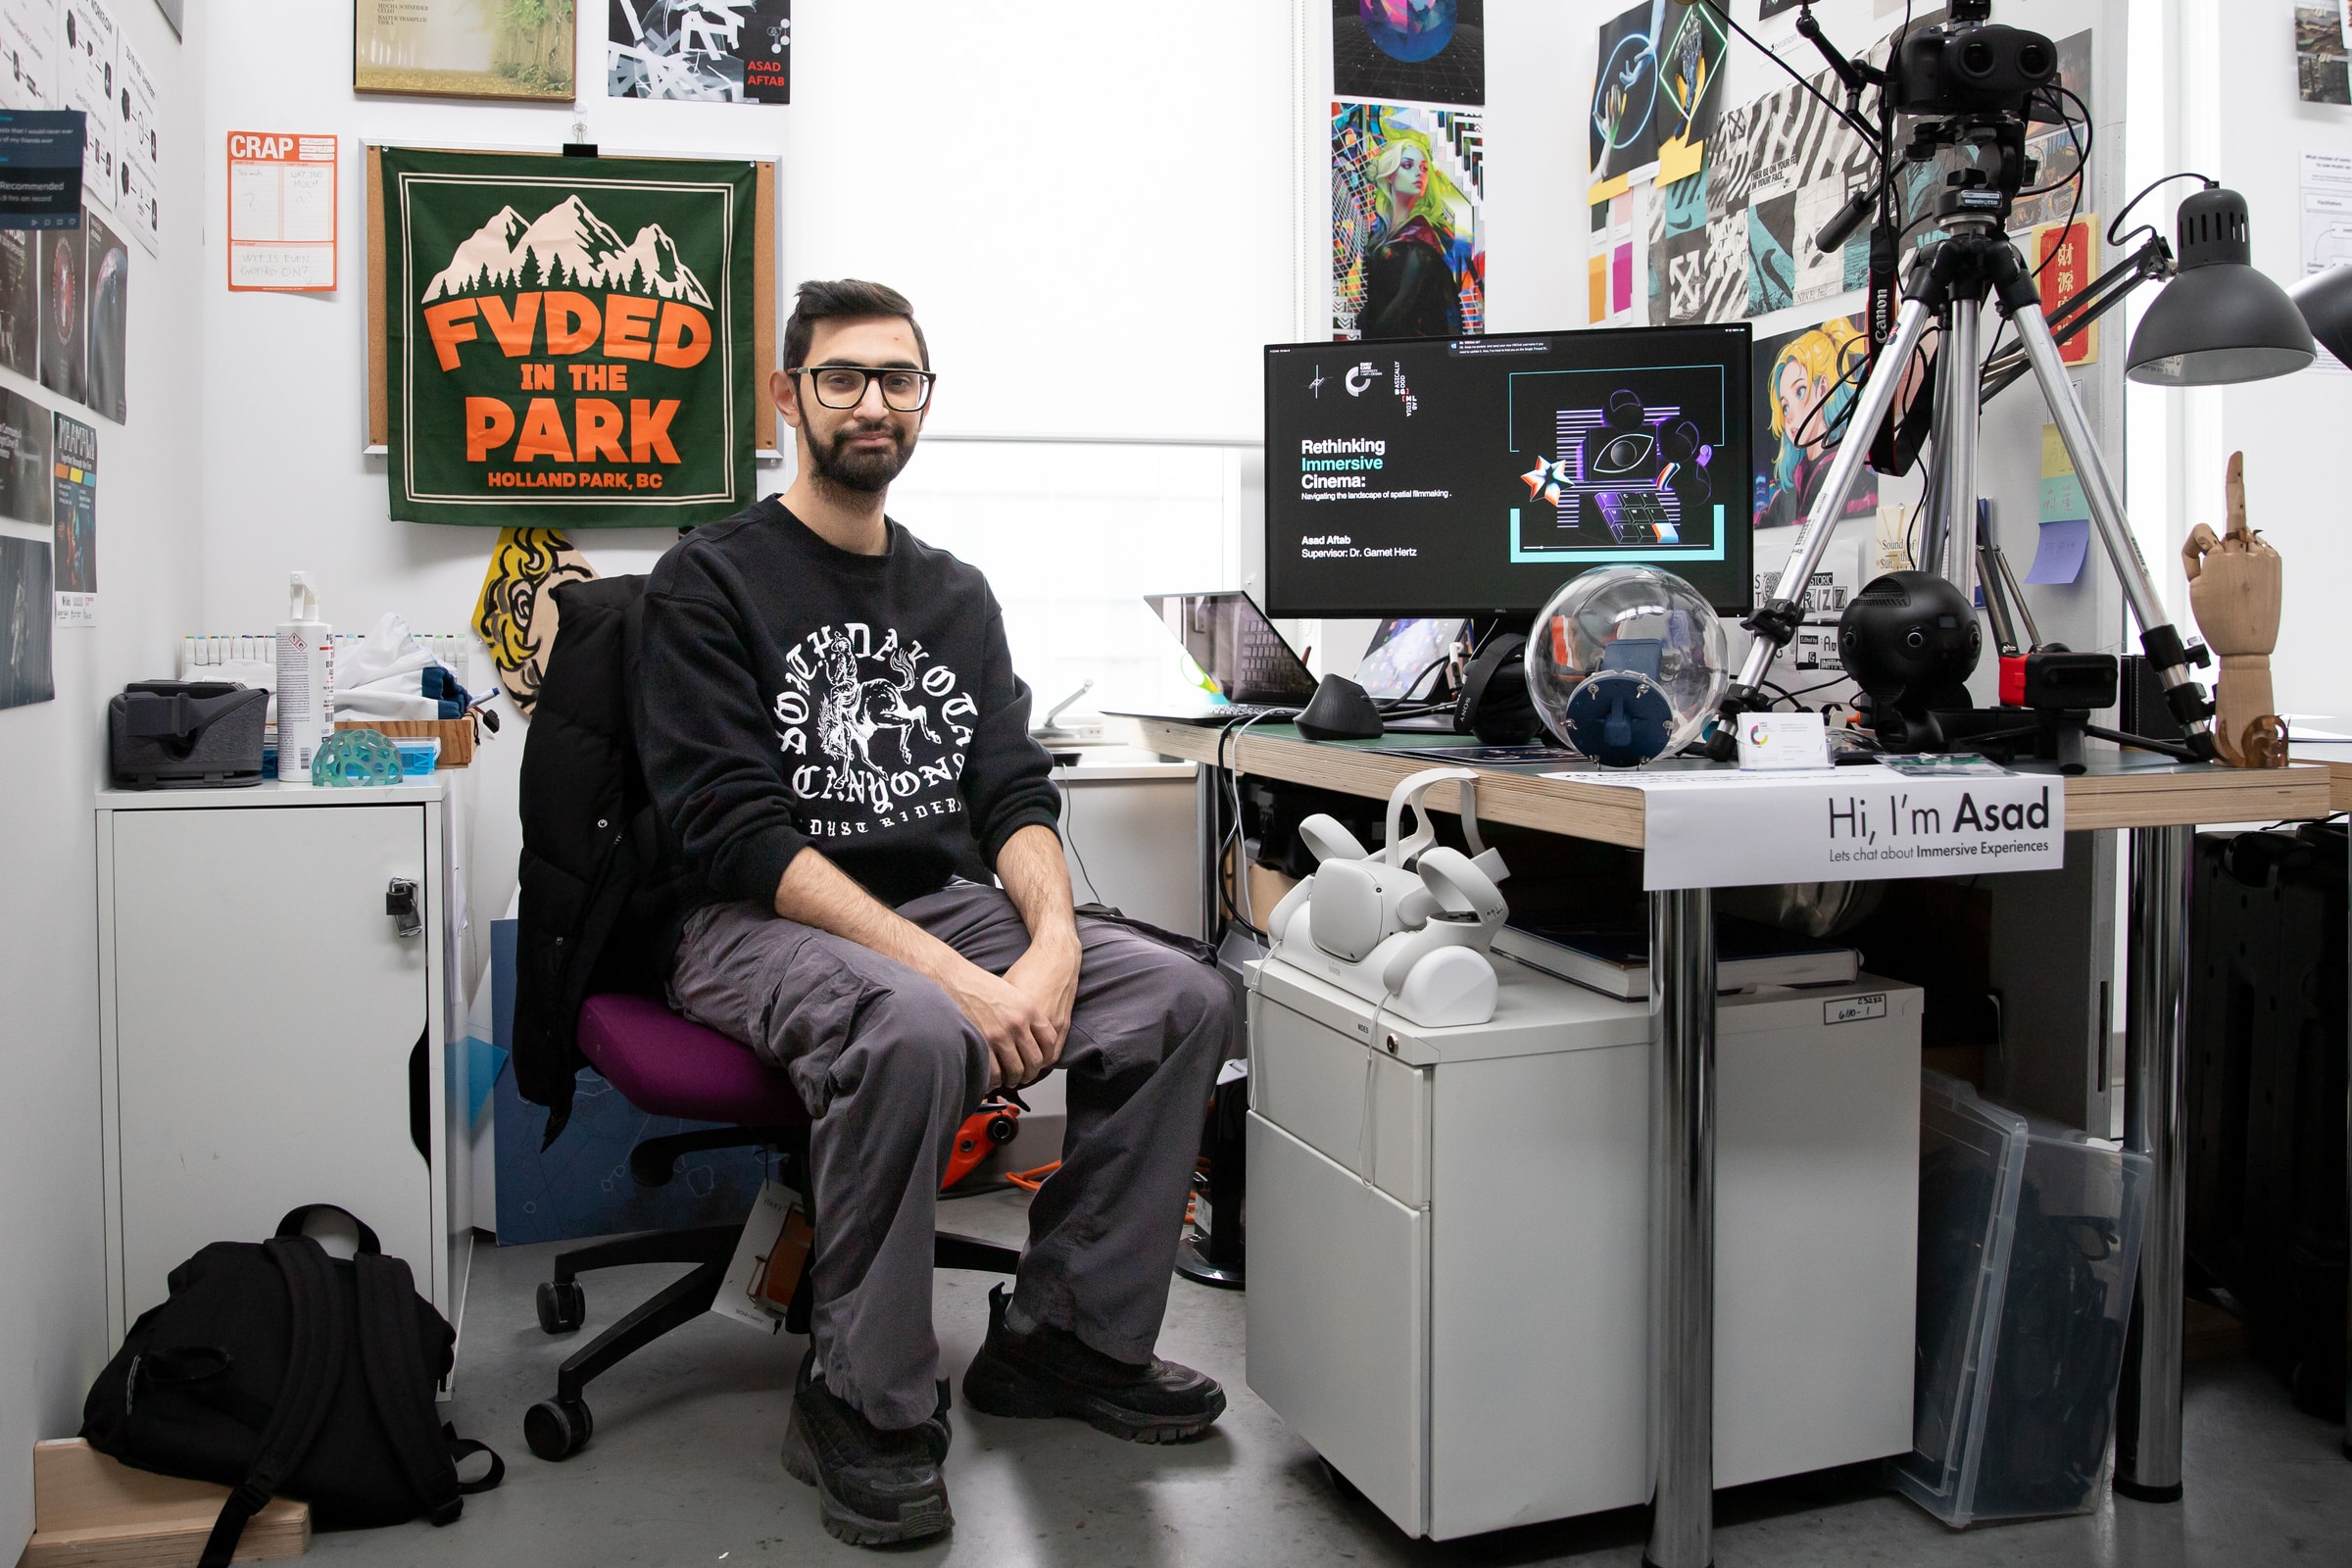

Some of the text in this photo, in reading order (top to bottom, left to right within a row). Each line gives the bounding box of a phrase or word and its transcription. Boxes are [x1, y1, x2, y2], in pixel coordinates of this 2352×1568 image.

[747, 60, 782, 72] ASAD
[747, 75, 785, 87] AFTAB
[231, 135, 294, 159] CRAP
[0, 181, 64, 191] Recommended
[1874, 289, 1888, 344] Canon
[423, 290, 713, 373] FVDED
[520, 364, 628, 392] IN THE
[465, 396, 682, 465] PARK
[1301, 438, 1385, 456] Rethinking
[1301, 456, 1383, 471] Immersive
[488, 471, 663, 491] HOLLAND PARK, BC
[1301, 474, 1366, 489] Cinema:
[1301, 492, 1336, 501] Navigating
[1348, 491, 1382, 500] landscape
[1390, 490, 1412, 499] spatial
[1301, 535, 1351, 545] Asad Aftab
[1882, 538, 1904, 550] Sound
[1301, 548, 1417, 559] Supervisor: Dr. Garnet Hertz
[1460, 697, 1471, 722] SONY
[1829, 785, 2049, 846] Hi, I'm Asad
[810, 818, 869, 837] DUST
[1829, 840, 2049, 862] Lets chat about Immersive Experiences
[764, 1198, 783, 1213] Hexy
